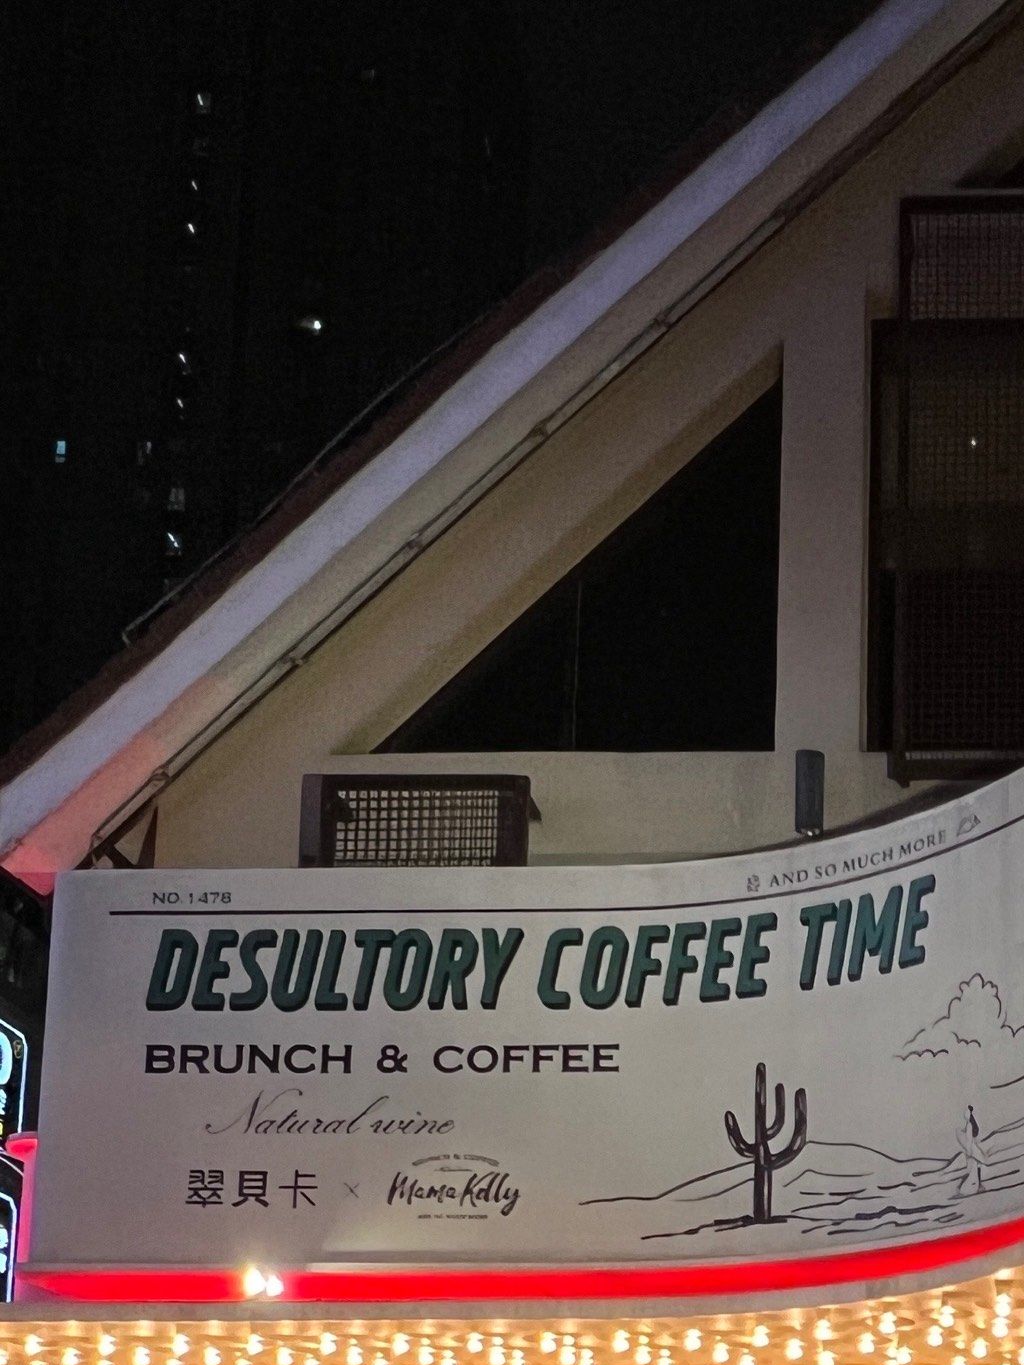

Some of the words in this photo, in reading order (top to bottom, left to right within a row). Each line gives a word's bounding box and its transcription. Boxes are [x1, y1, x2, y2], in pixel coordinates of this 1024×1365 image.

[769, 870, 809, 888] AND
[814, 862, 837, 880] SO
[842, 849, 894, 873] MUCH
[899, 829, 947, 857] MORE
[145, 928, 525, 1012] DESULTORY
[536, 912, 778, 1011] COFFEE
[799, 874, 936, 992] TIME
[145, 1044, 352, 1074] BRUNCH
[377, 1046, 407, 1074] &
[433, 1043, 620, 1075] COFFEE
[205, 1088, 389, 1135] Natural
[369, 1111, 456, 1135] wine
[185, 1169, 318, 1209] 翠貝卡
